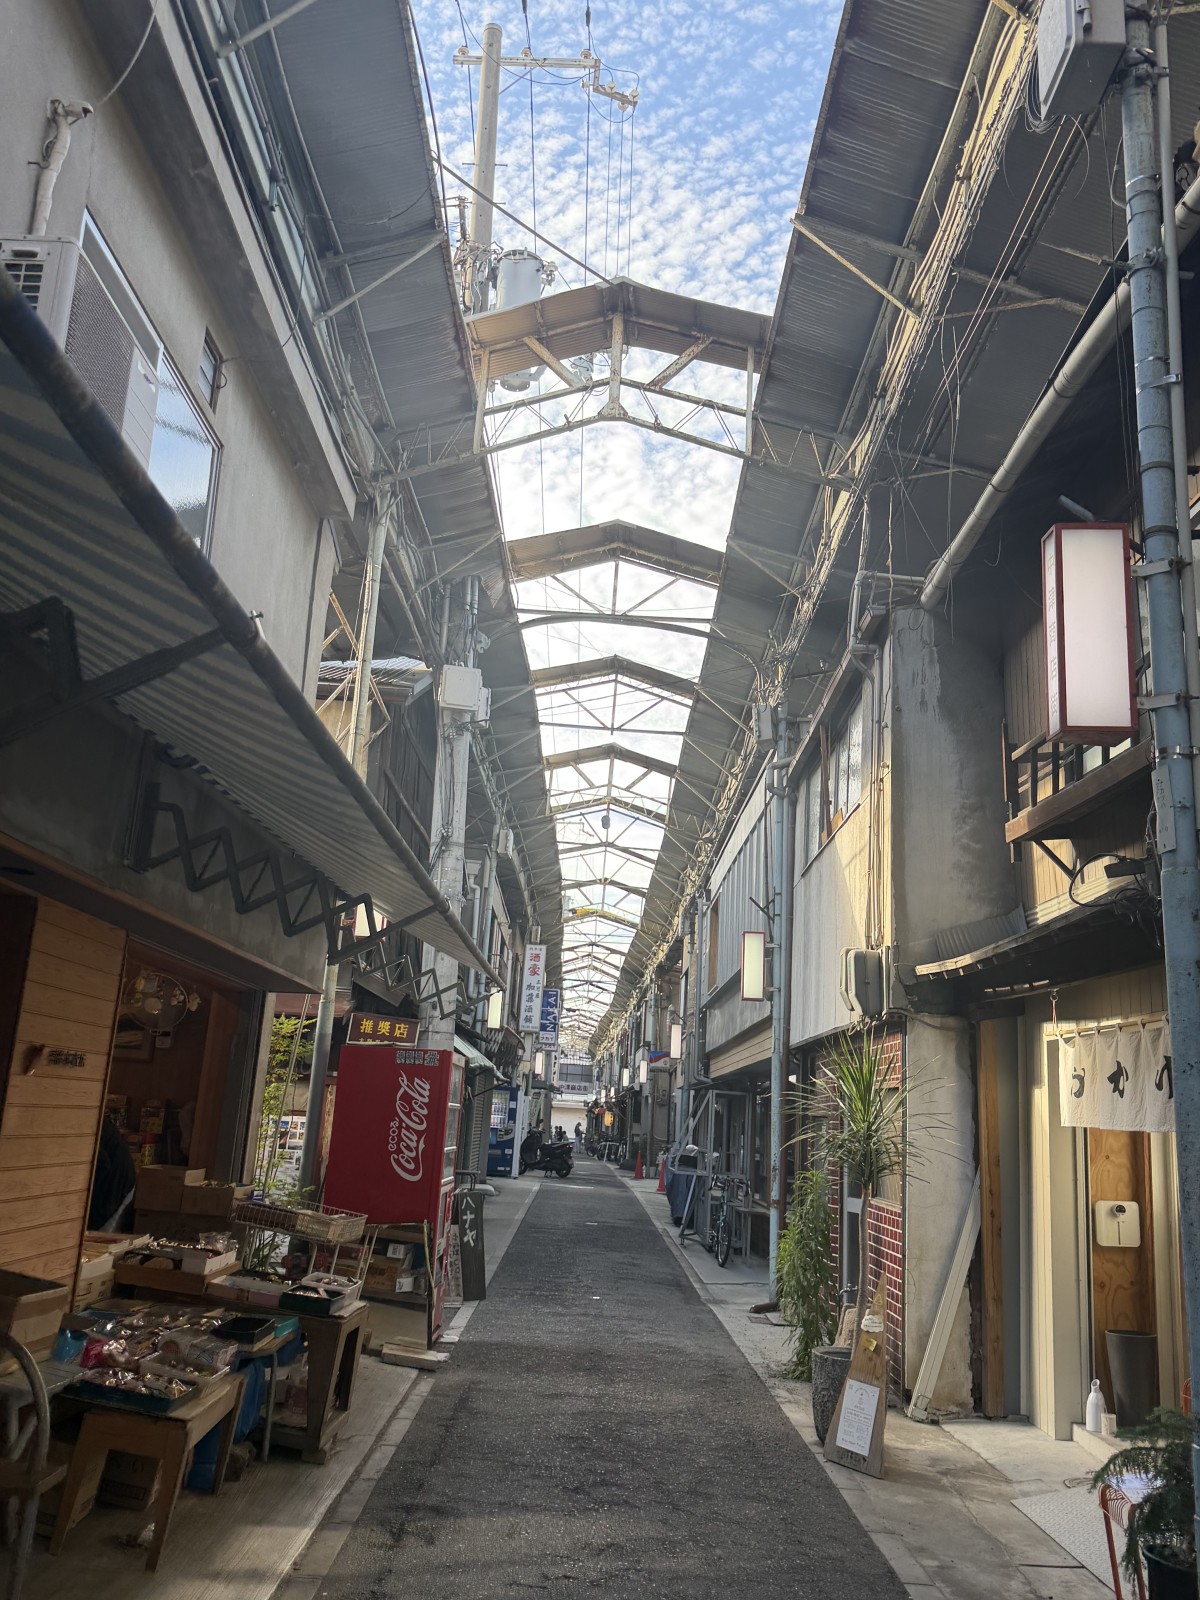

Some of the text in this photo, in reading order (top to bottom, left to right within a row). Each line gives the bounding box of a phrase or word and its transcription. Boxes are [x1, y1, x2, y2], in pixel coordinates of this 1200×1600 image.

[391, 1069, 431, 1182] Coca-Cola
[462, 1196, 477, 1247] ハナヤ
